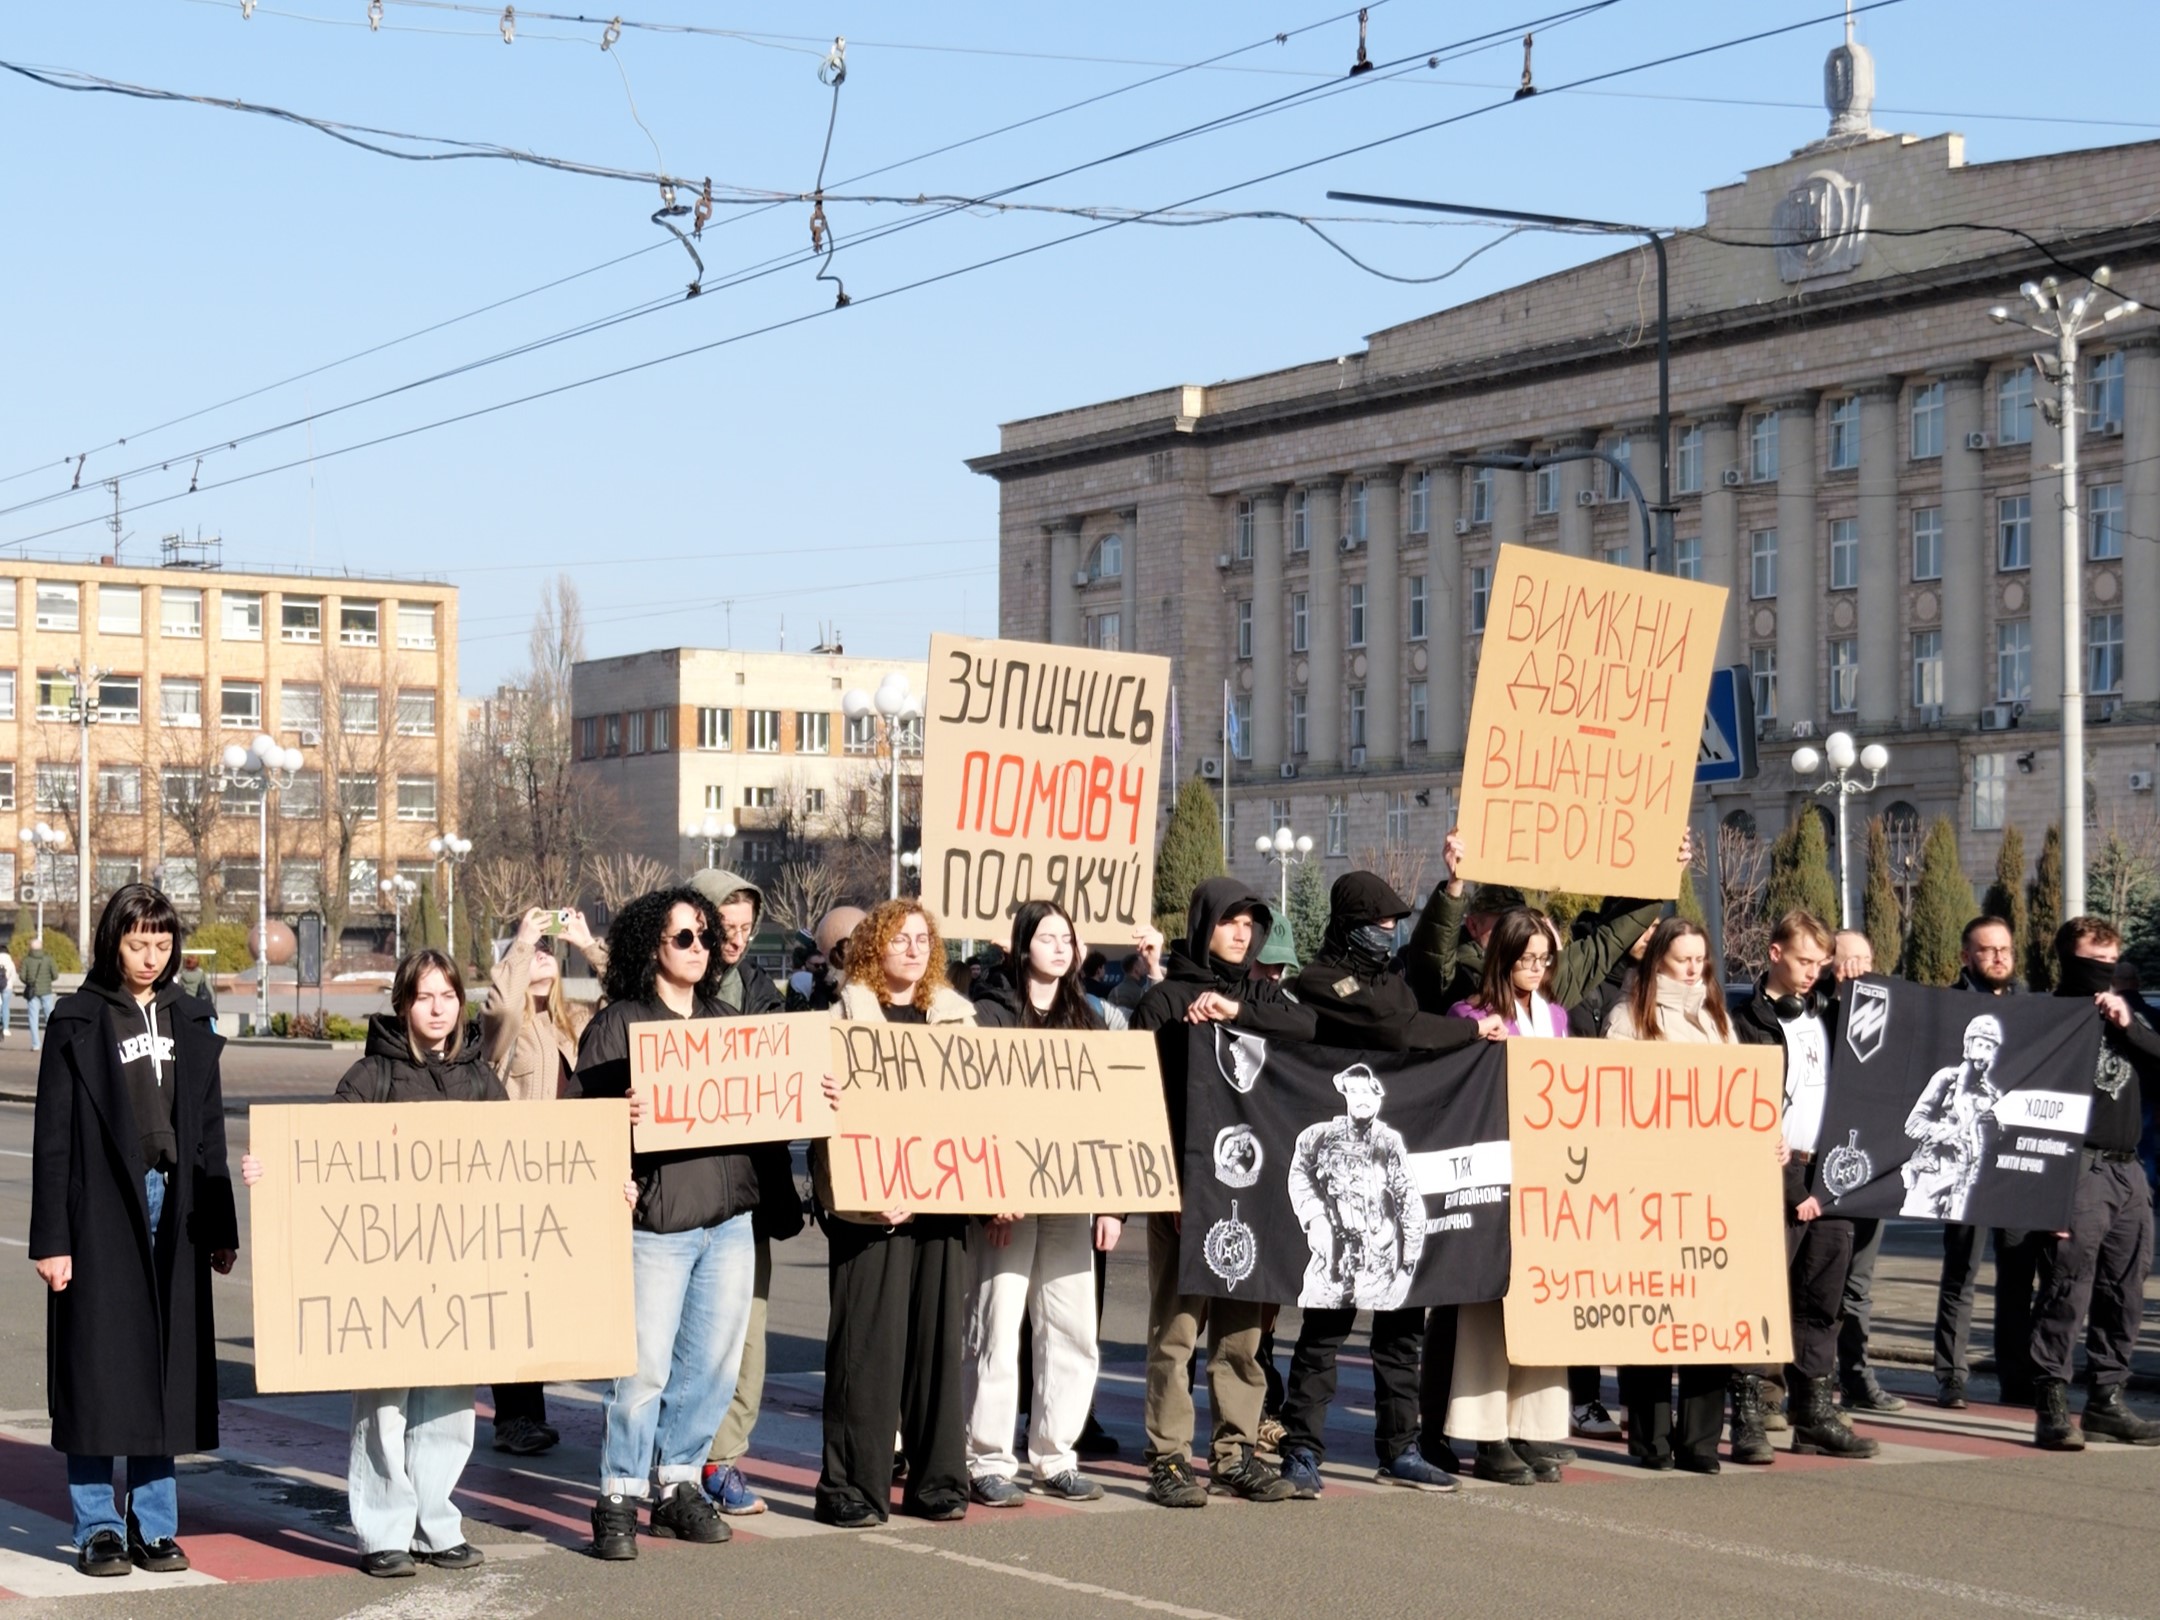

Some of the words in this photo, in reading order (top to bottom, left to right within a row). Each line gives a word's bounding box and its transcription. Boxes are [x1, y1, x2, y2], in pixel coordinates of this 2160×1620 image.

[1507, 574, 1693, 673] ВИМКНИ
[939, 650, 1154, 745] ЗУПИНИСЬ
[1506, 650, 1672, 732] ДВИГУН
[957, 750, 1144, 845] ПОМОВЧ
[1482, 726, 1674, 815] ВШАНУЙ
[1480, 799, 1636, 869] ГЕРОЇВ
[942, 848, 1141, 925] ПОДЯКУЙ
[638, 1021, 791, 1073] ПАМ'ЯТАЙ
[929, 1033, 1101, 1092] ХВИЛИНА
[654, 1072, 803, 1133] ЩОДНЯ
[1523, 1059, 1777, 1132] ЗУПИНИСЬ
[2025, 1098, 2064, 1119] ХОДОР
[294, 1123, 598, 1184] НАЦІОНАЛЬНА
[841, 1134, 1006, 1200] ТИСЯЧІ
[1015, 1137, 1175, 1199] ЖИТТІВ!
[1565, 1146, 1588, 1184] У
[321, 1203, 573, 1265] ХВИЛИНА
[1519, 1187, 1728, 1241] ПАМ'ЯТЬ
[1527, 1266, 1696, 1304] ЗУПИНЕНІ
[1680, 1246, 1728, 1269] ПРО
[298, 1273, 535, 1355] ПАМ'ЯТІ
[1573, 1303, 1674, 1330] ВОРОГОМ
